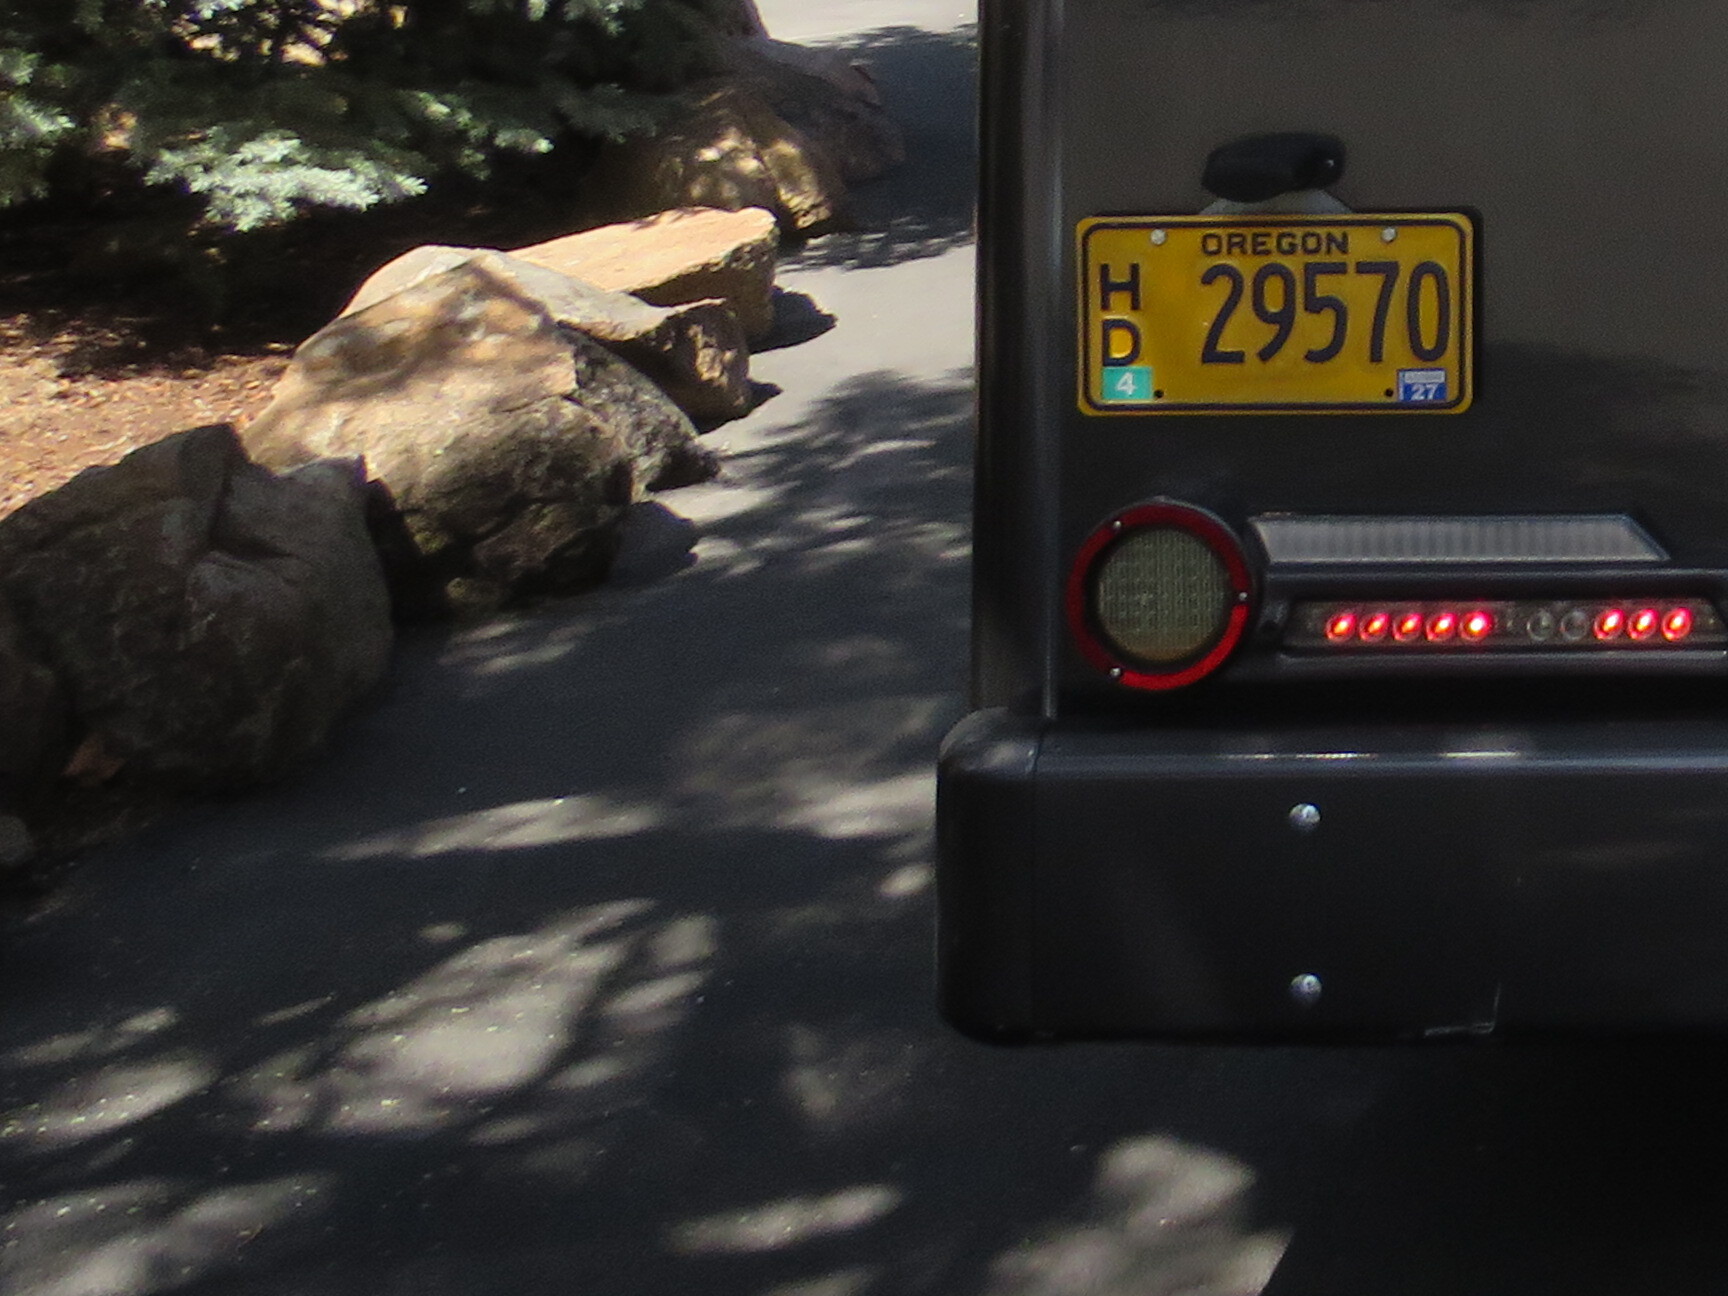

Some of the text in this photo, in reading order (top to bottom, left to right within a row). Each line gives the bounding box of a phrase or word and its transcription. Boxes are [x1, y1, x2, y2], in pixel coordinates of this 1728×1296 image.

[1201, 231, 1349, 256] OREGON
[1201, 260, 1450, 365] 29570
[1115, 371, 1137, 396] 4
[1410, 382, 1439, 401] 27
